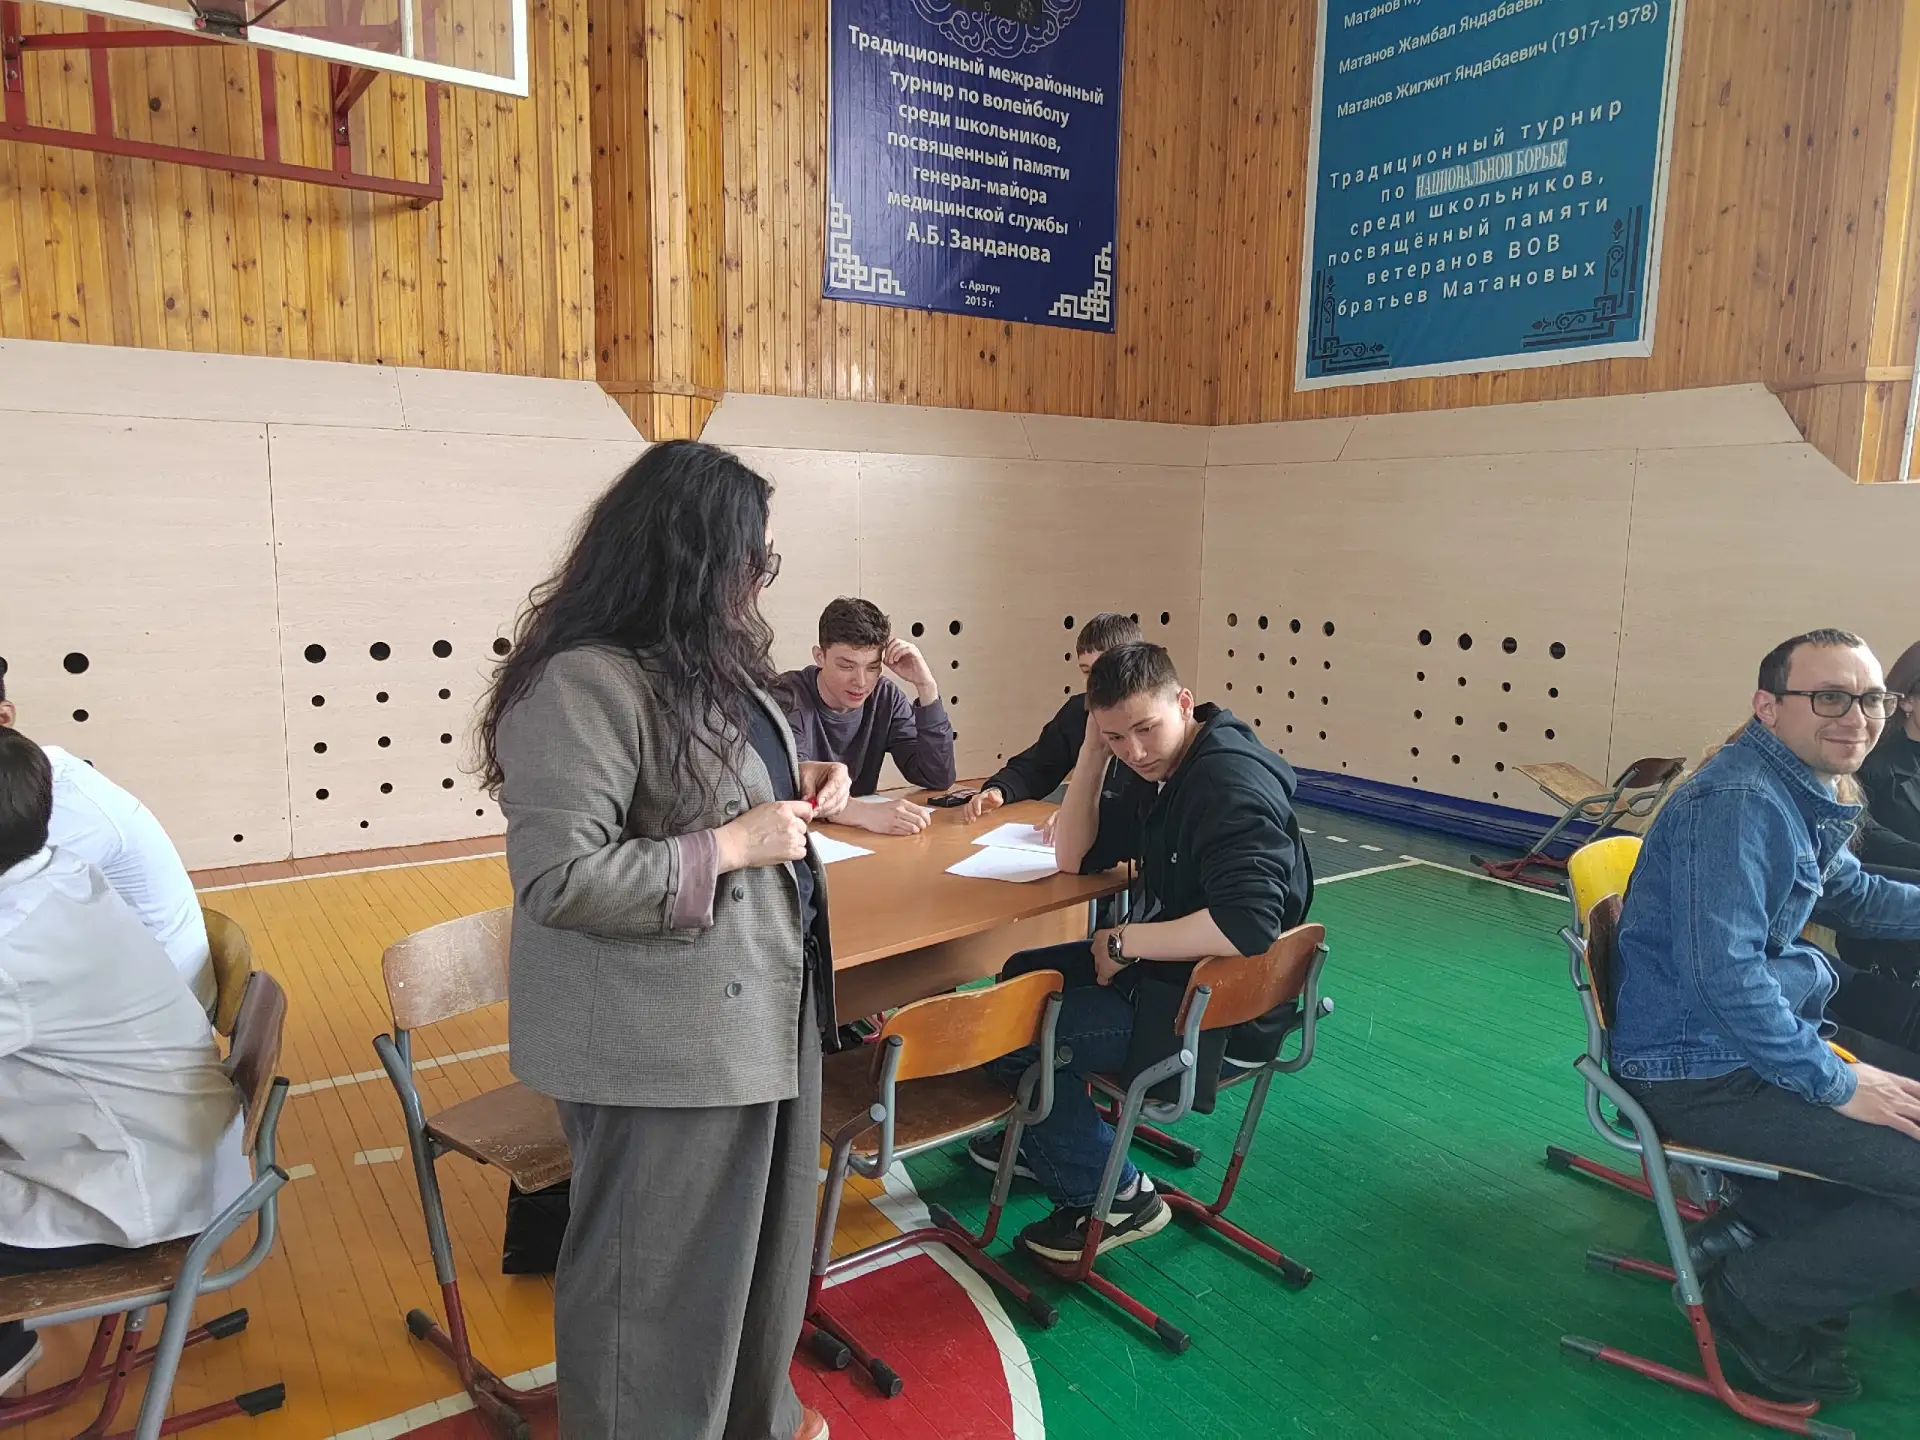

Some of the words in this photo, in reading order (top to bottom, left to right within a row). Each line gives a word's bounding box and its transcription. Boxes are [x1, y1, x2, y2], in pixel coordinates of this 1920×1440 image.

[1339, 46, 1395, 75] Матанов
[1398, 25, 1456, 54] Жамбал
[1459, 0, 1545, 33] Яндабаеви
[1344, 0, 1400, 29] Матанов
[848, 24, 985, 76] Традиционный
[988, 64, 1104, 105] межрайонный
[1337, 90, 1393, 118] Матанов
[1396, 71, 1452, 100] Жигжит
[1455, 41, 1548, 82] Яндабаевич
[1551, 2, 1659, 54] (1917-1978)
[890, 70, 954, 101] турнир
[959, 87, 979, 104] по
[983, 91, 1070, 129] волейболу
[888, 131, 1009, 169] посвященный
[1013, 158, 1070, 181] памяти
[898, 103, 951, 128] среди
[955, 115, 1061, 153] школьников,
[1330, 128, 1505, 189] Традиционный
[1520, 98, 1622, 141] турнир
[913, 165, 1047, 205] генерал-майора
[1381, 185, 1404, 203] по
[1516, 139, 1568, 176] БОРЬБЕ
[888, 191, 1004, 224] медицинской
[1008, 213, 1069, 235] службы
[1350, 208, 1416, 237] среди
[1429, 169, 1605, 220] школьников,
[906, 221, 945, 247] А.Б.
[950, 228, 1051, 264] Занданова
[1328, 218, 1490, 268] посвящённый
[1505, 196, 1609, 232] памяти
[1367, 248, 1494, 286] ветеранов
[1508, 232, 1561, 261] ВОВ
[965, 295, 987, 307] 2015
[968, 280, 1000, 295] Арзгун
[1337, 287, 1429, 318] братьев
[1443, 260, 1596, 300] Матановых
